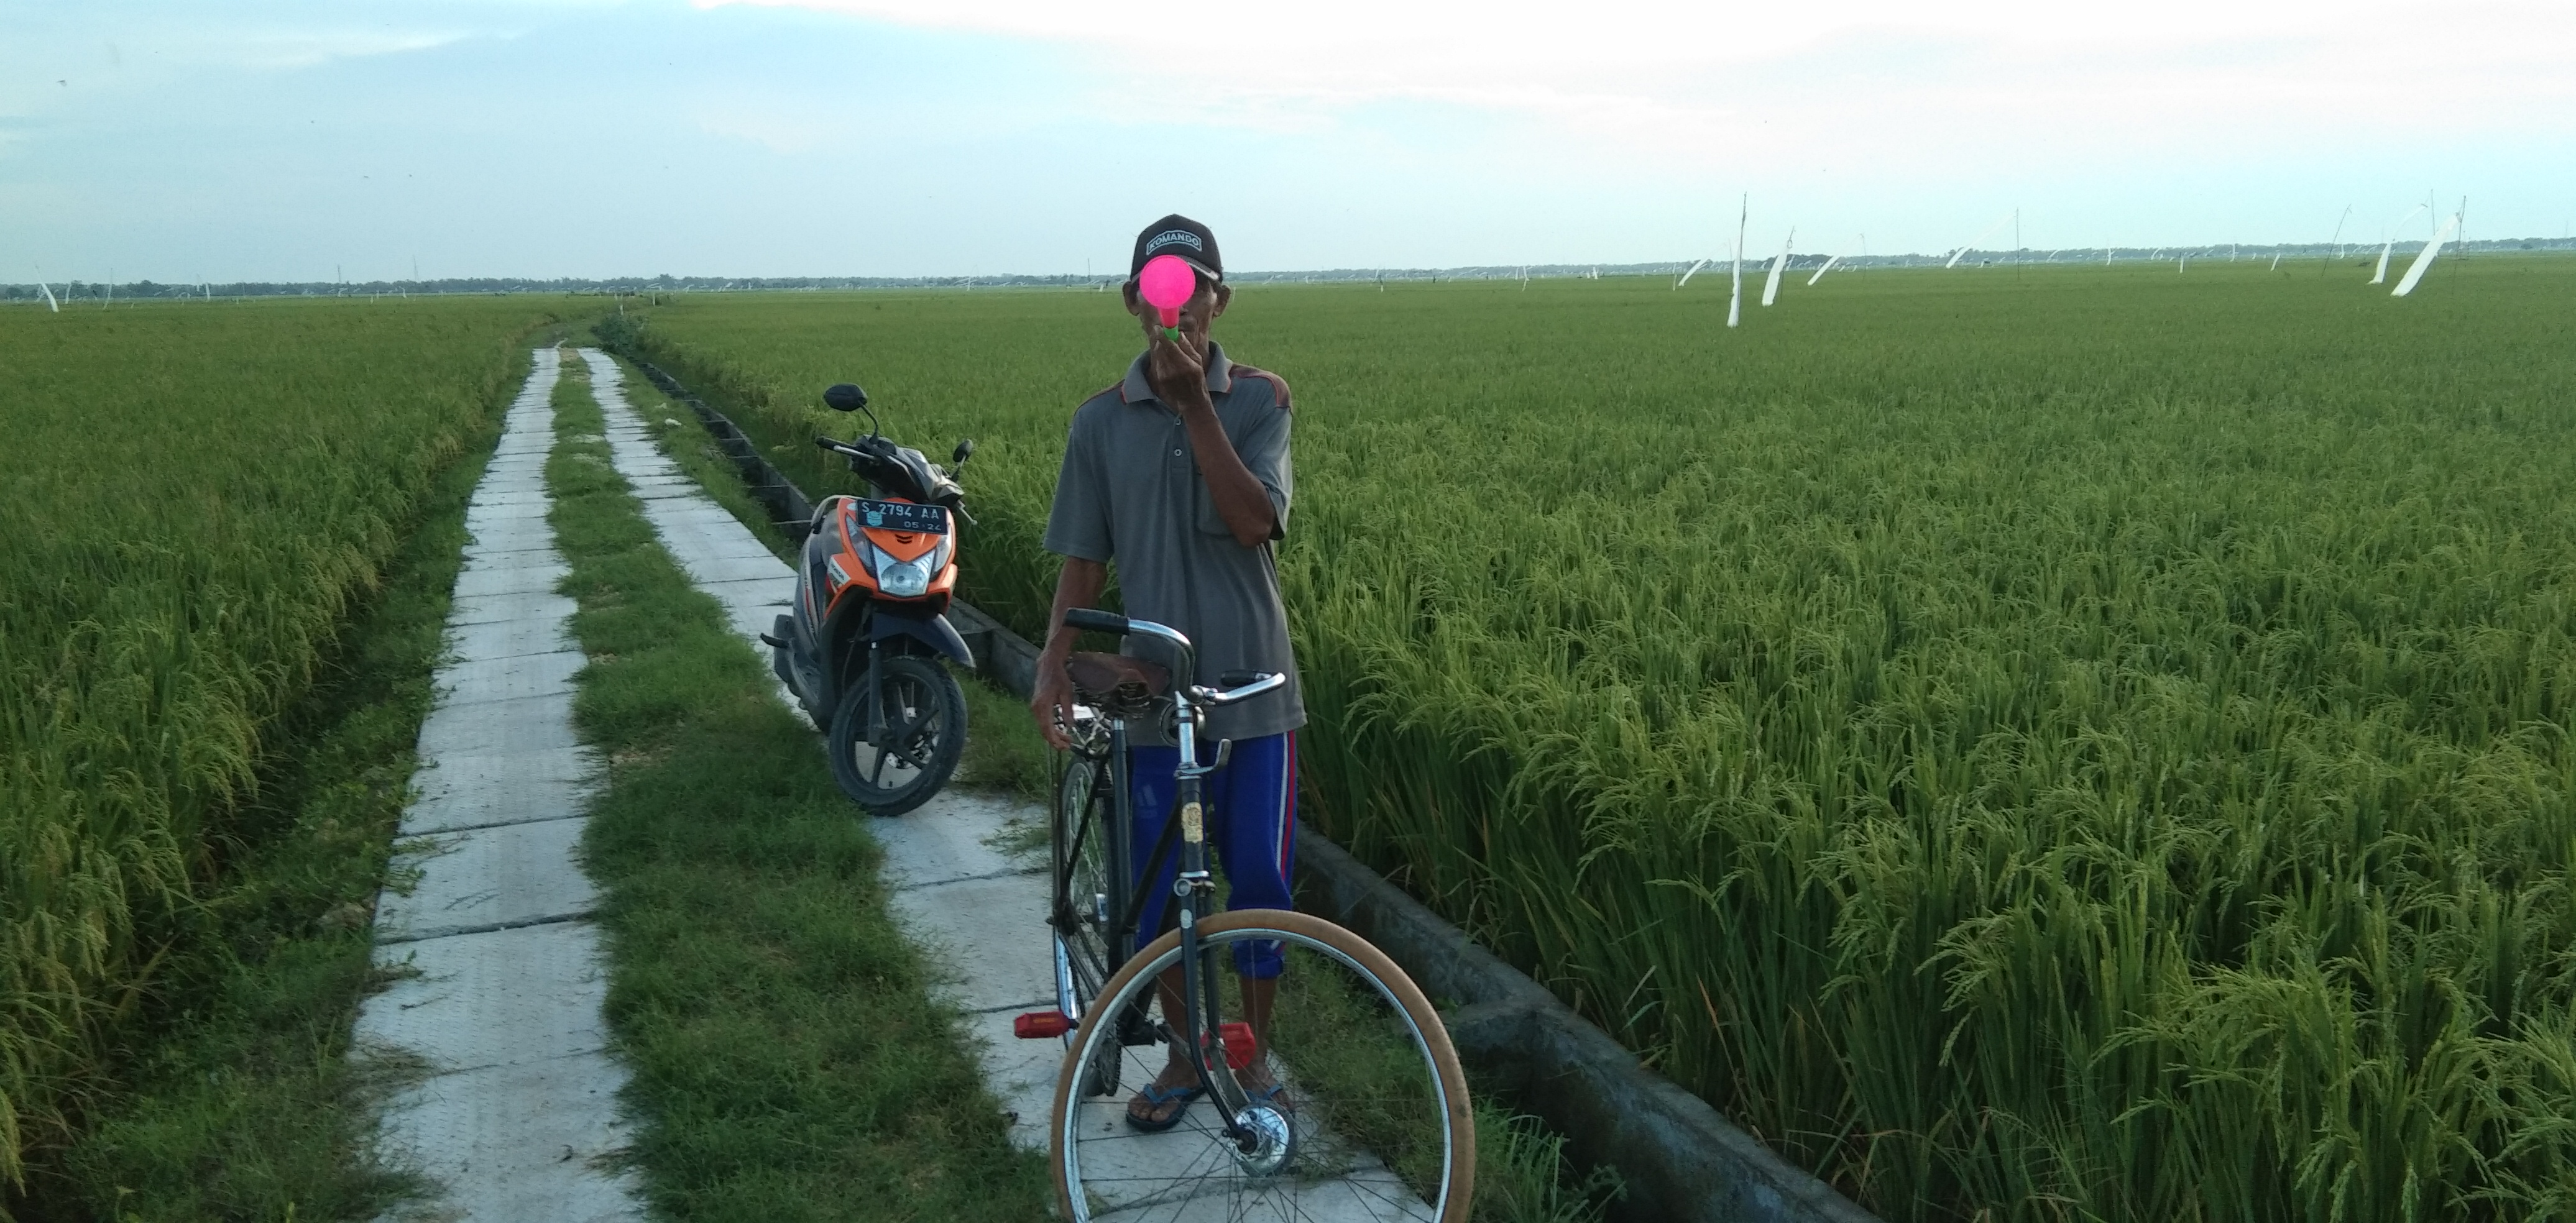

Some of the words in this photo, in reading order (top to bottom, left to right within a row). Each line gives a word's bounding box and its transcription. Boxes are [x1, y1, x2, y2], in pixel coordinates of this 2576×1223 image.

[1149, 232, 1200, 251] KOMANDO
[862, 502, 870, 513] S
[878, 503, 913, 517] 2794
[921, 507, 940, 520] AA
